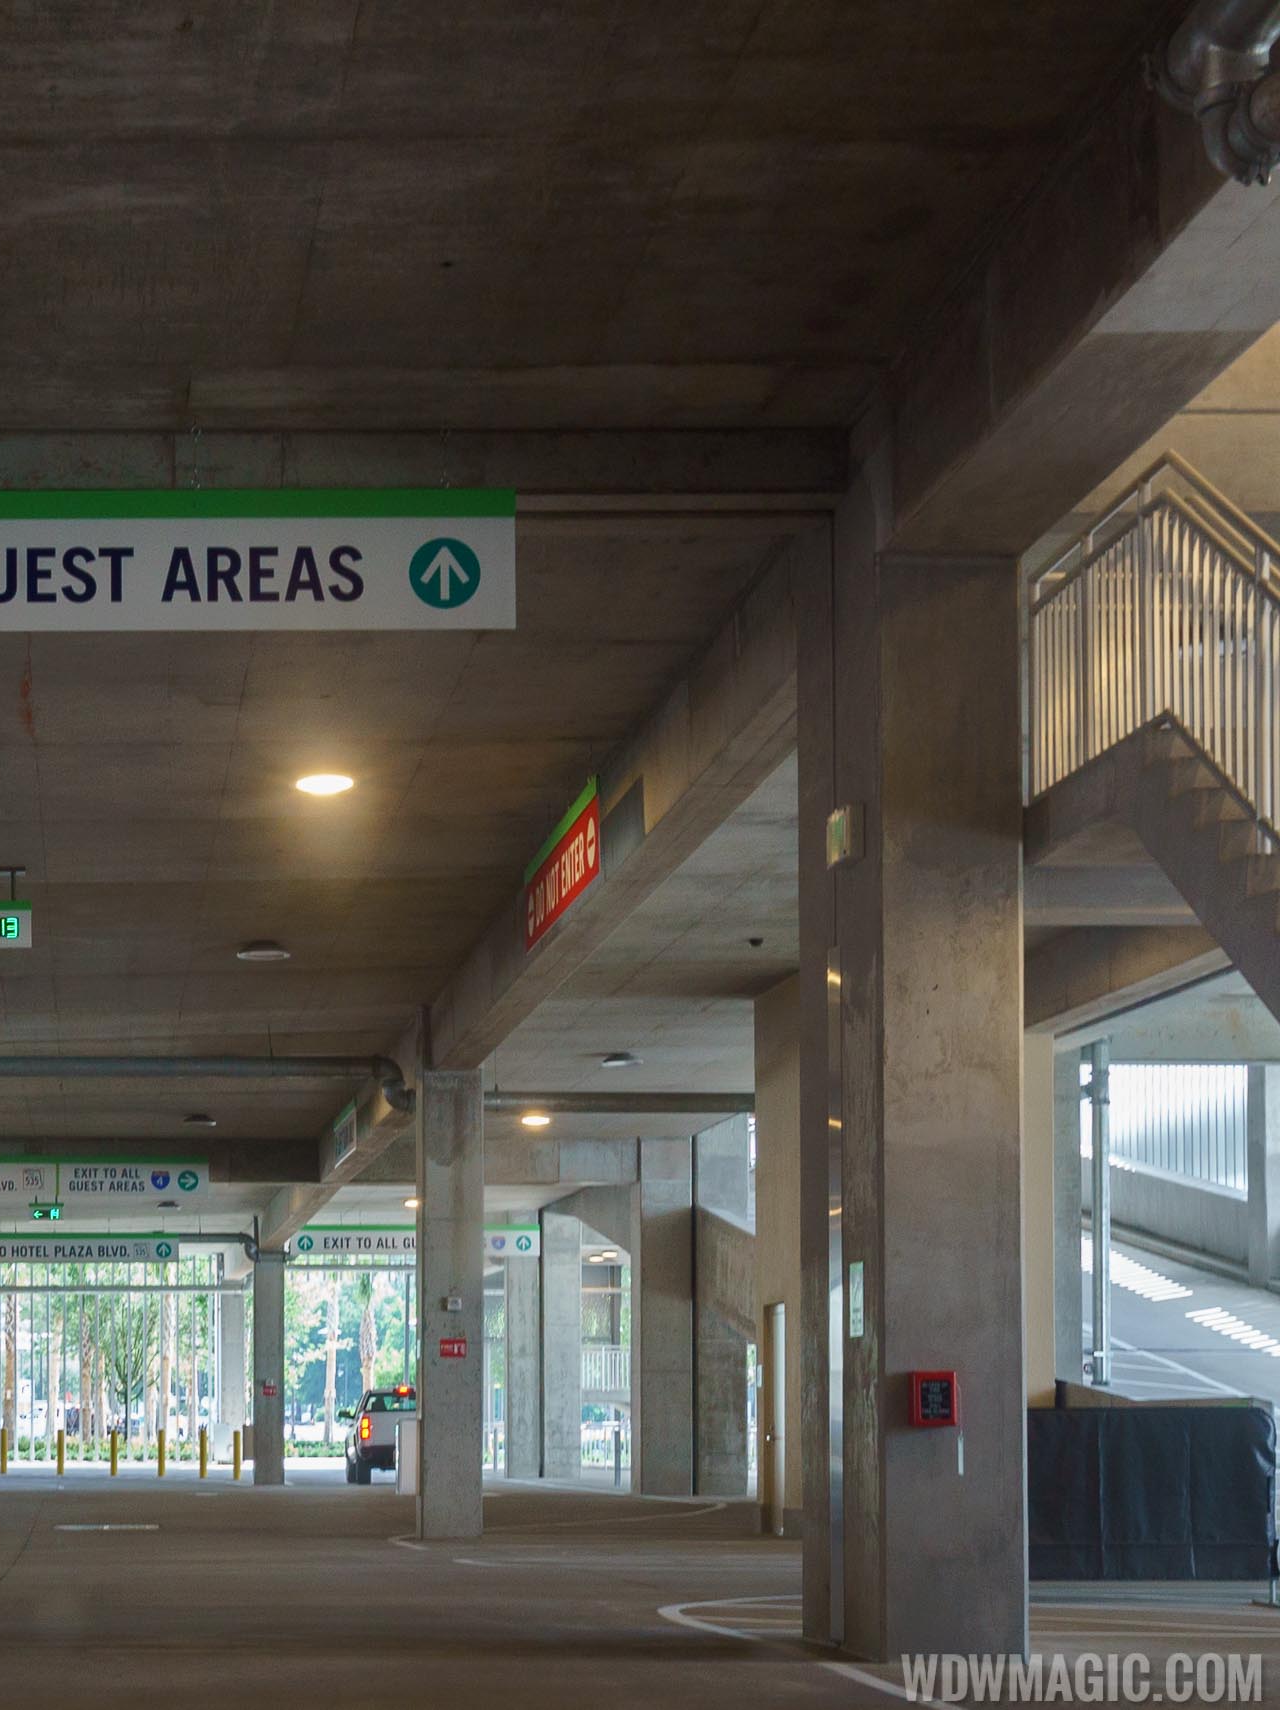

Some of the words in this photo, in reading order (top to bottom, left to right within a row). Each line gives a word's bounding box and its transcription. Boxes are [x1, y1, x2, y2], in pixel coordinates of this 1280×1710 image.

[161, 545, 364, 603] AREAS
[545, 861, 560, 915] NOT
[560, 832, 585, 899] ENTER
[74, 1167, 99, 1179] EXIT
[103, 1167, 117, 1179] TO
[121, 1167, 140, 1179] ALL
[69, 1180, 105, 1192] GUEST
[109, 1180, 145, 1192] AREAS
[324, 1236, 351, 1249] EXIT
[356, 1236, 371, 1249] TO
[376, 1237, 398, 1249] ALL
[11, 1245, 49, 1258] HOTEL
[54, 1245, 94, 1258] PLAZA
[98, 1245, 130, 1258] BLVD.
